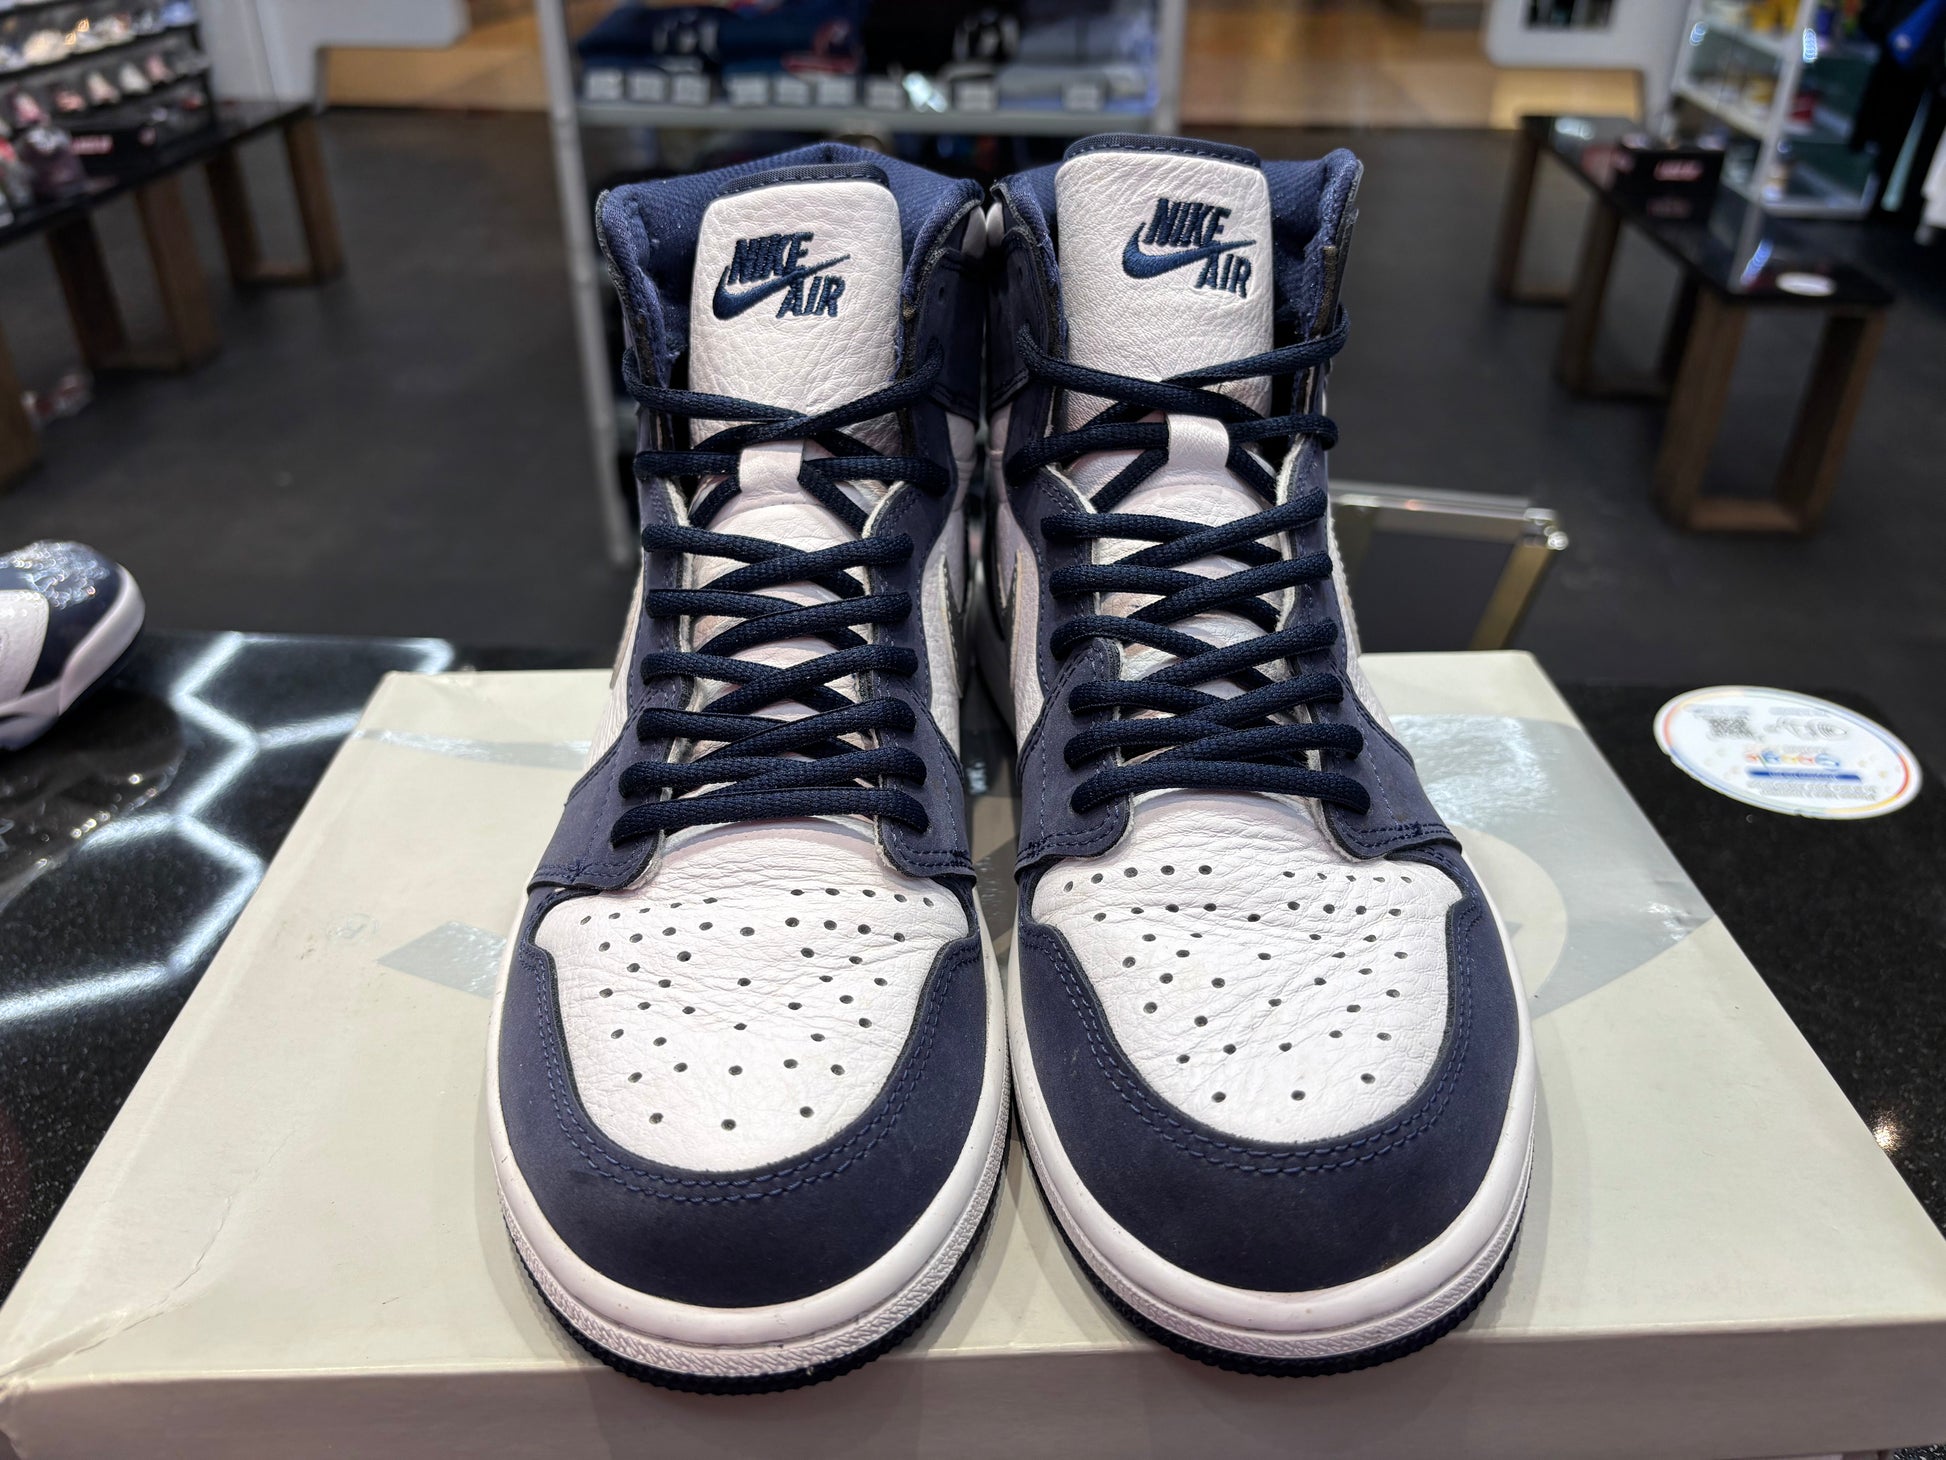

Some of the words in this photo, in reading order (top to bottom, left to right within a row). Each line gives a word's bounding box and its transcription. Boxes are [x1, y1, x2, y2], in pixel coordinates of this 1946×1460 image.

[1141, 198, 1232, 248] NIKE
[727, 232, 814, 286] NIKE
[1194, 253, 1251, 299] AIR
[775, 274, 845, 319] AIR
